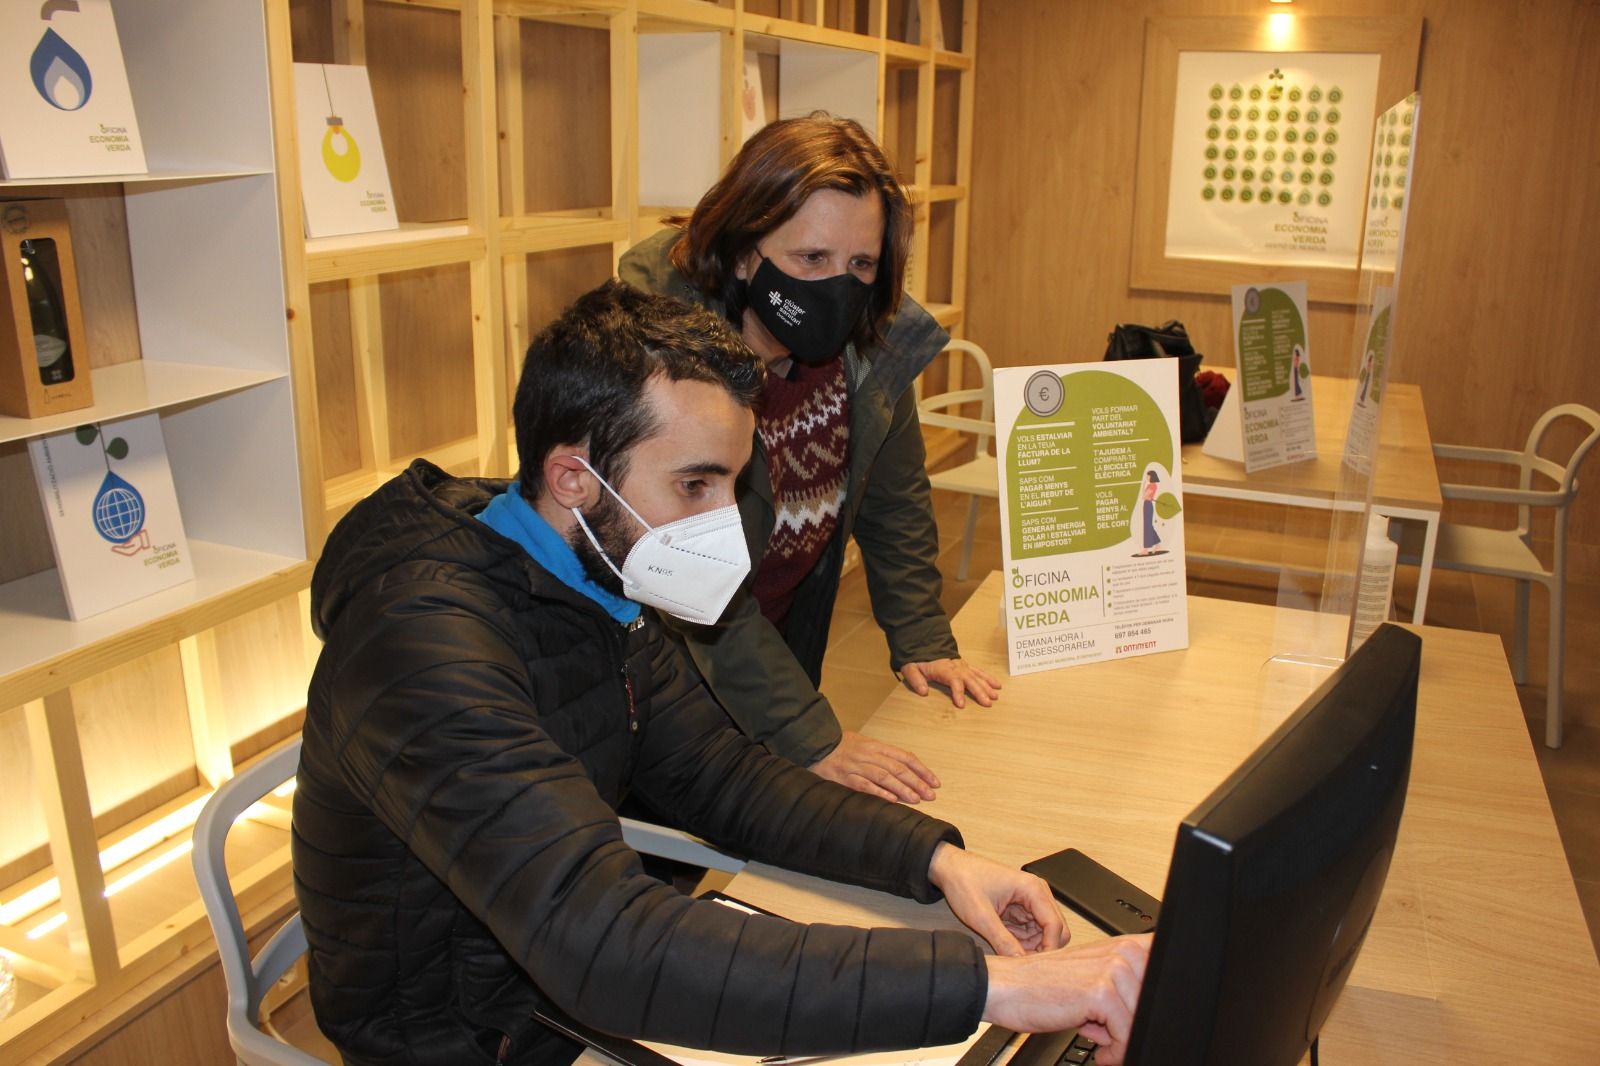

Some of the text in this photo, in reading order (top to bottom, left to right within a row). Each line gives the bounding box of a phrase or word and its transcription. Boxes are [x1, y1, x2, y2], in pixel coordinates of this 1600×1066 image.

[89, 136, 128, 144] ECONOMIA
[1274, 224, 1328, 234] ECONOMIA
[1292, 235, 1326, 244] VERDA
[1092, 404, 1138, 414] VOLS FORMAR
[1092, 420, 1136, 430] VOLUNTARIAT
[1017, 432, 1073, 442] VOLS ESTALVIAR
[1093, 428, 1134, 438] AMBIENTAL?
[1038, 441, 1056, 449] TEUA
[1018, 450, 1050, 458] FACTURA
[1094, 454, 1136, 464] COMPRAR-TE
[1018, 458, 1041, 466] LLUM?
[1104, 462, 1136, 470] BICICLETA
[1020, 475, 1055, 485] SAPS COM
[1020, 482, 1068, 492] PAGAR MENYS
[1020, 493, 1030, 501] EN
[1031, 492, 1040, 500] EL
[1040, 490, 1064, 498] REBUT
[1096, 490, 1112, 498] VOLS
[1020, 499, 1052, 508] L'AIGUA?
[1096, 498, 1118, 506] PAGAR
[1096, 506, 1119, 514] MENYS
[1022, 516, 1056, 526] SAPS COM
[1096, 512, 1118, 522] REBUT
[1022, 521, 1086, 534] GENERAR ENERGIA
[1097, 522, 1110, 530] DEL
[1022, 533, 1046, 542] SOLAR
[1050, 528, 1086, 538] ESTALVIAR
[1034, 538, 1072, 548] IMPOSTOS?
[144, 550, 178, 566] ECONOMIA
[158, 558, 180, 568] VERDA
[648, 564, 672, 576] KN95
[1012, 570, 1070, 588] OFICINA
[1013, 585, 1100, 610] ECONOMIA
[1014, 609, 1070, 630] VERDA
[1016, 636, 1052, 650] DEMANA
[1054, 632, 1080, 644] HORA
[1016, 640, 1096, 660] T'ASSESSORAREM
